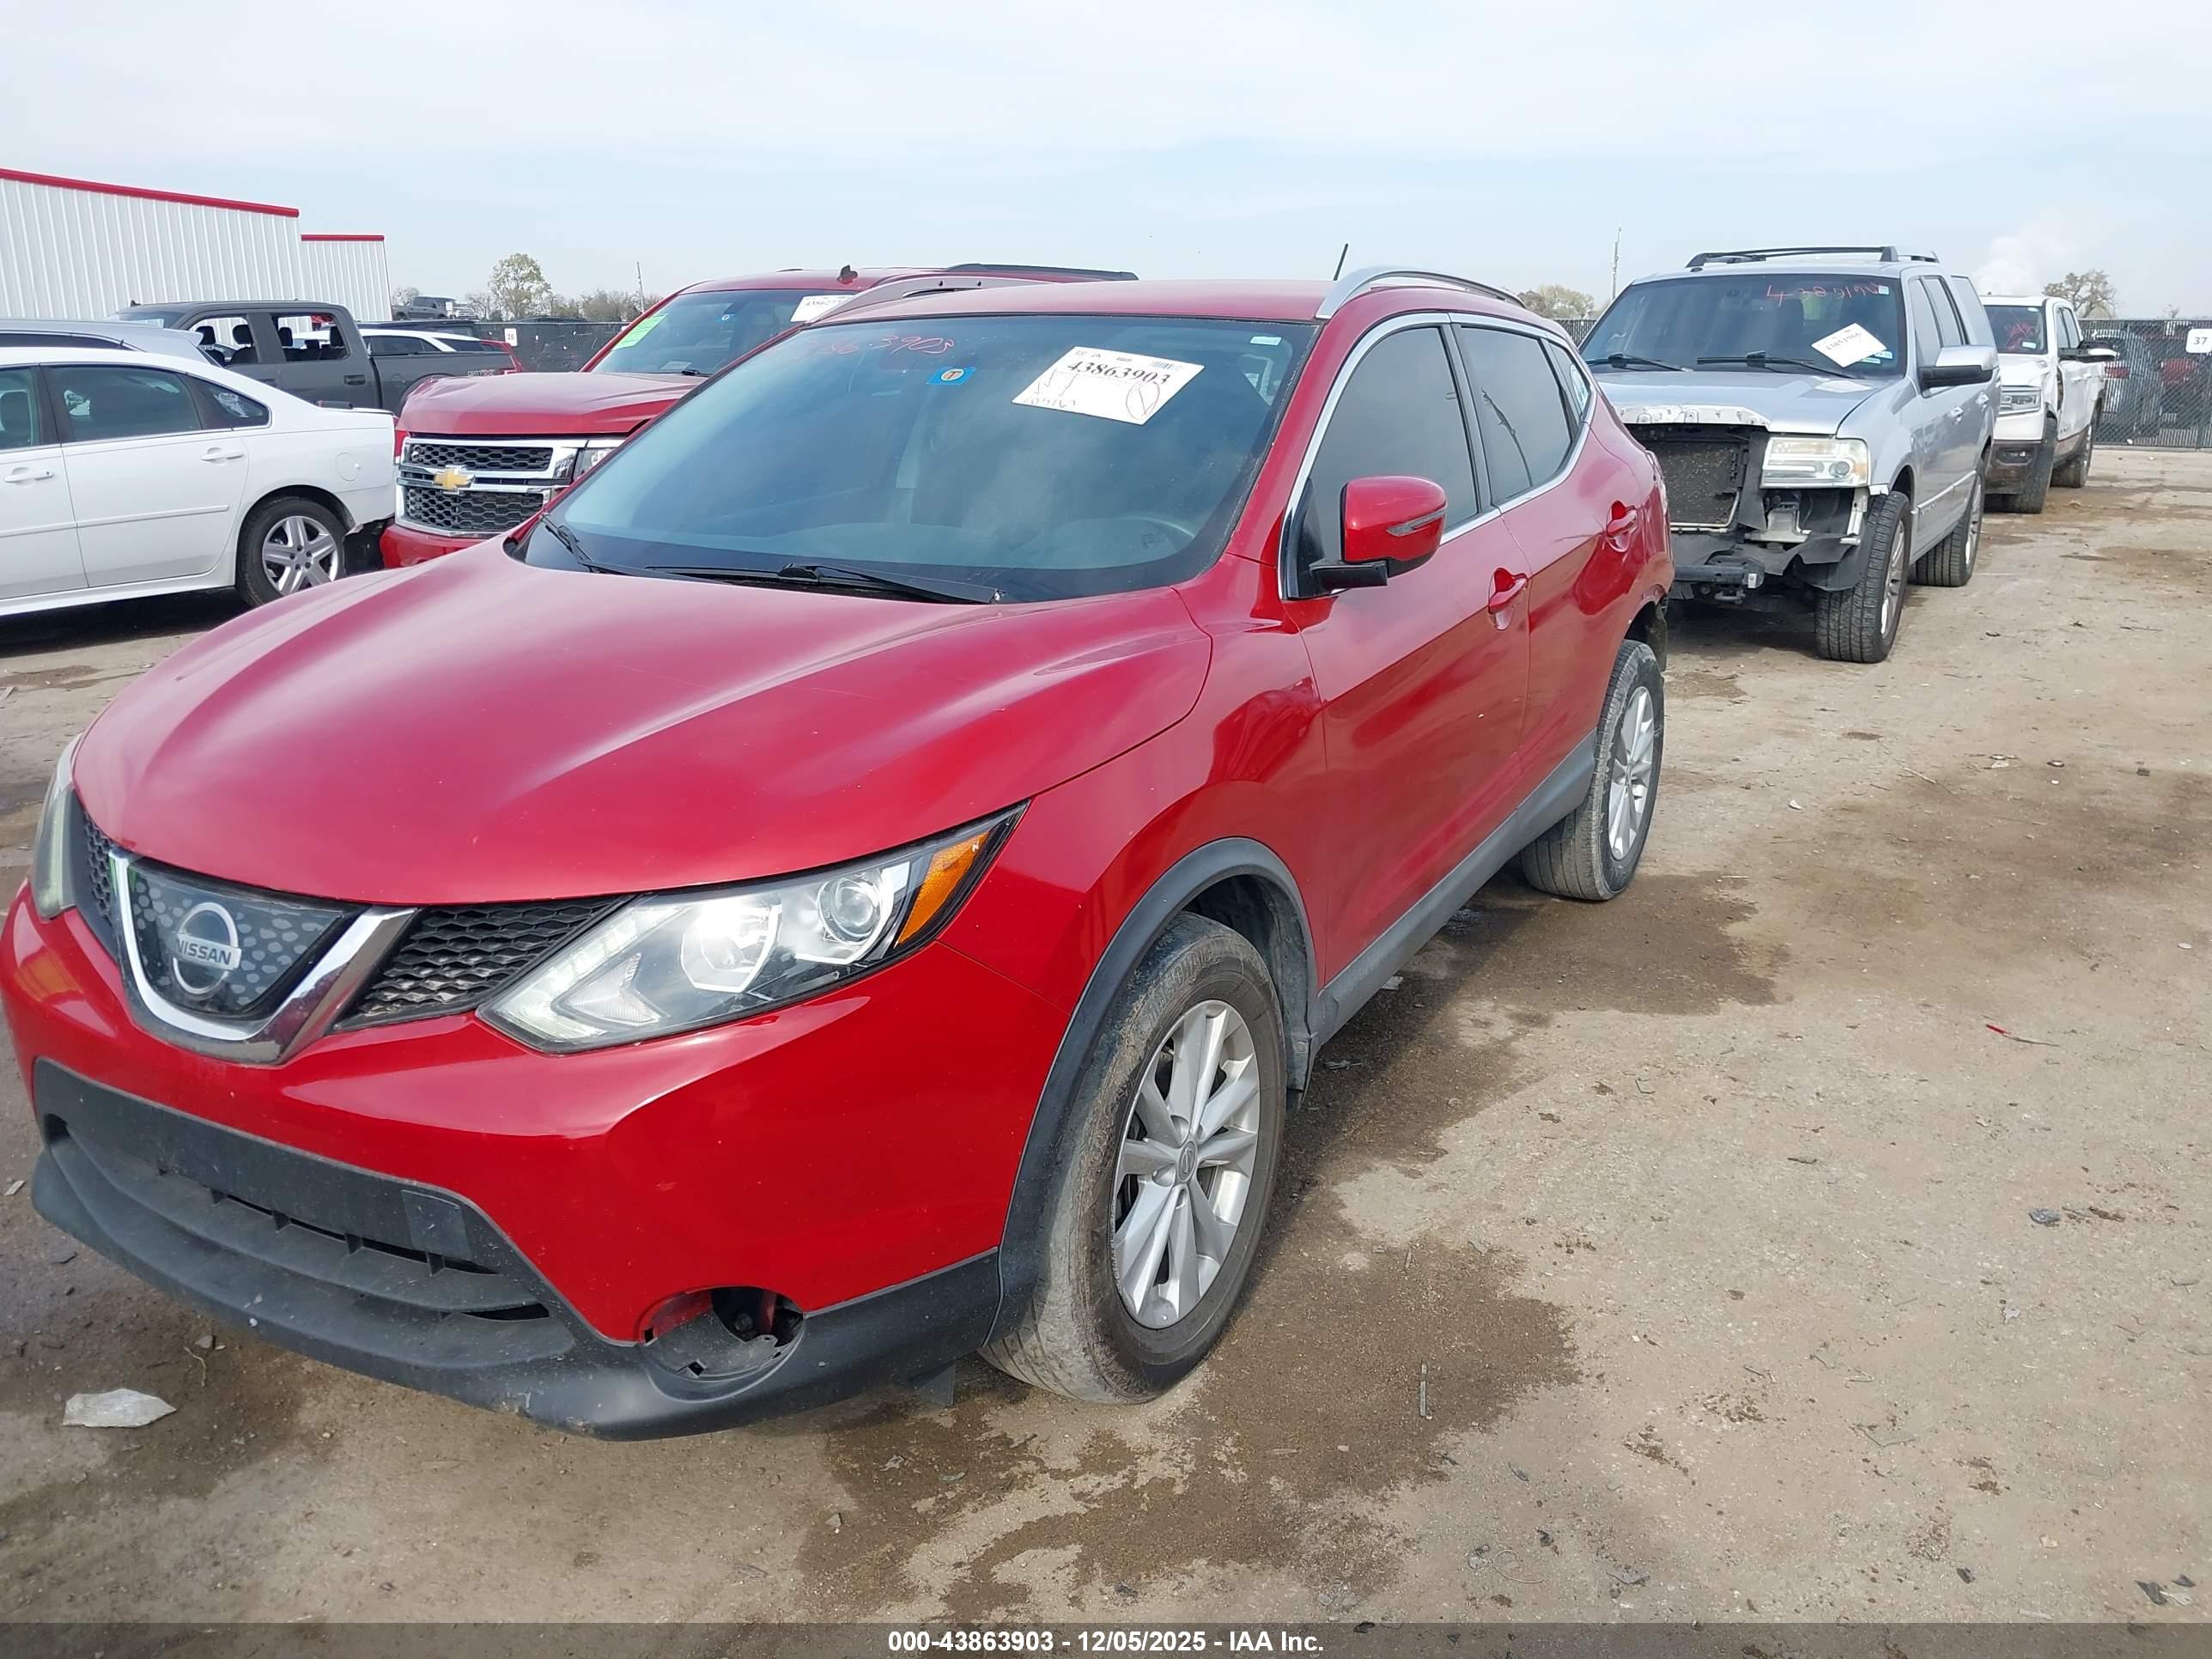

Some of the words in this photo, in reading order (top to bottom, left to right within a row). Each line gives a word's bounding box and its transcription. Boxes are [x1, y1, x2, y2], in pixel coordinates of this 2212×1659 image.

[2193, 336, 2209, 345] 37
[1066, 361, 1171, 386] 43863903
[177, 940, 232, 966] NISSAN
